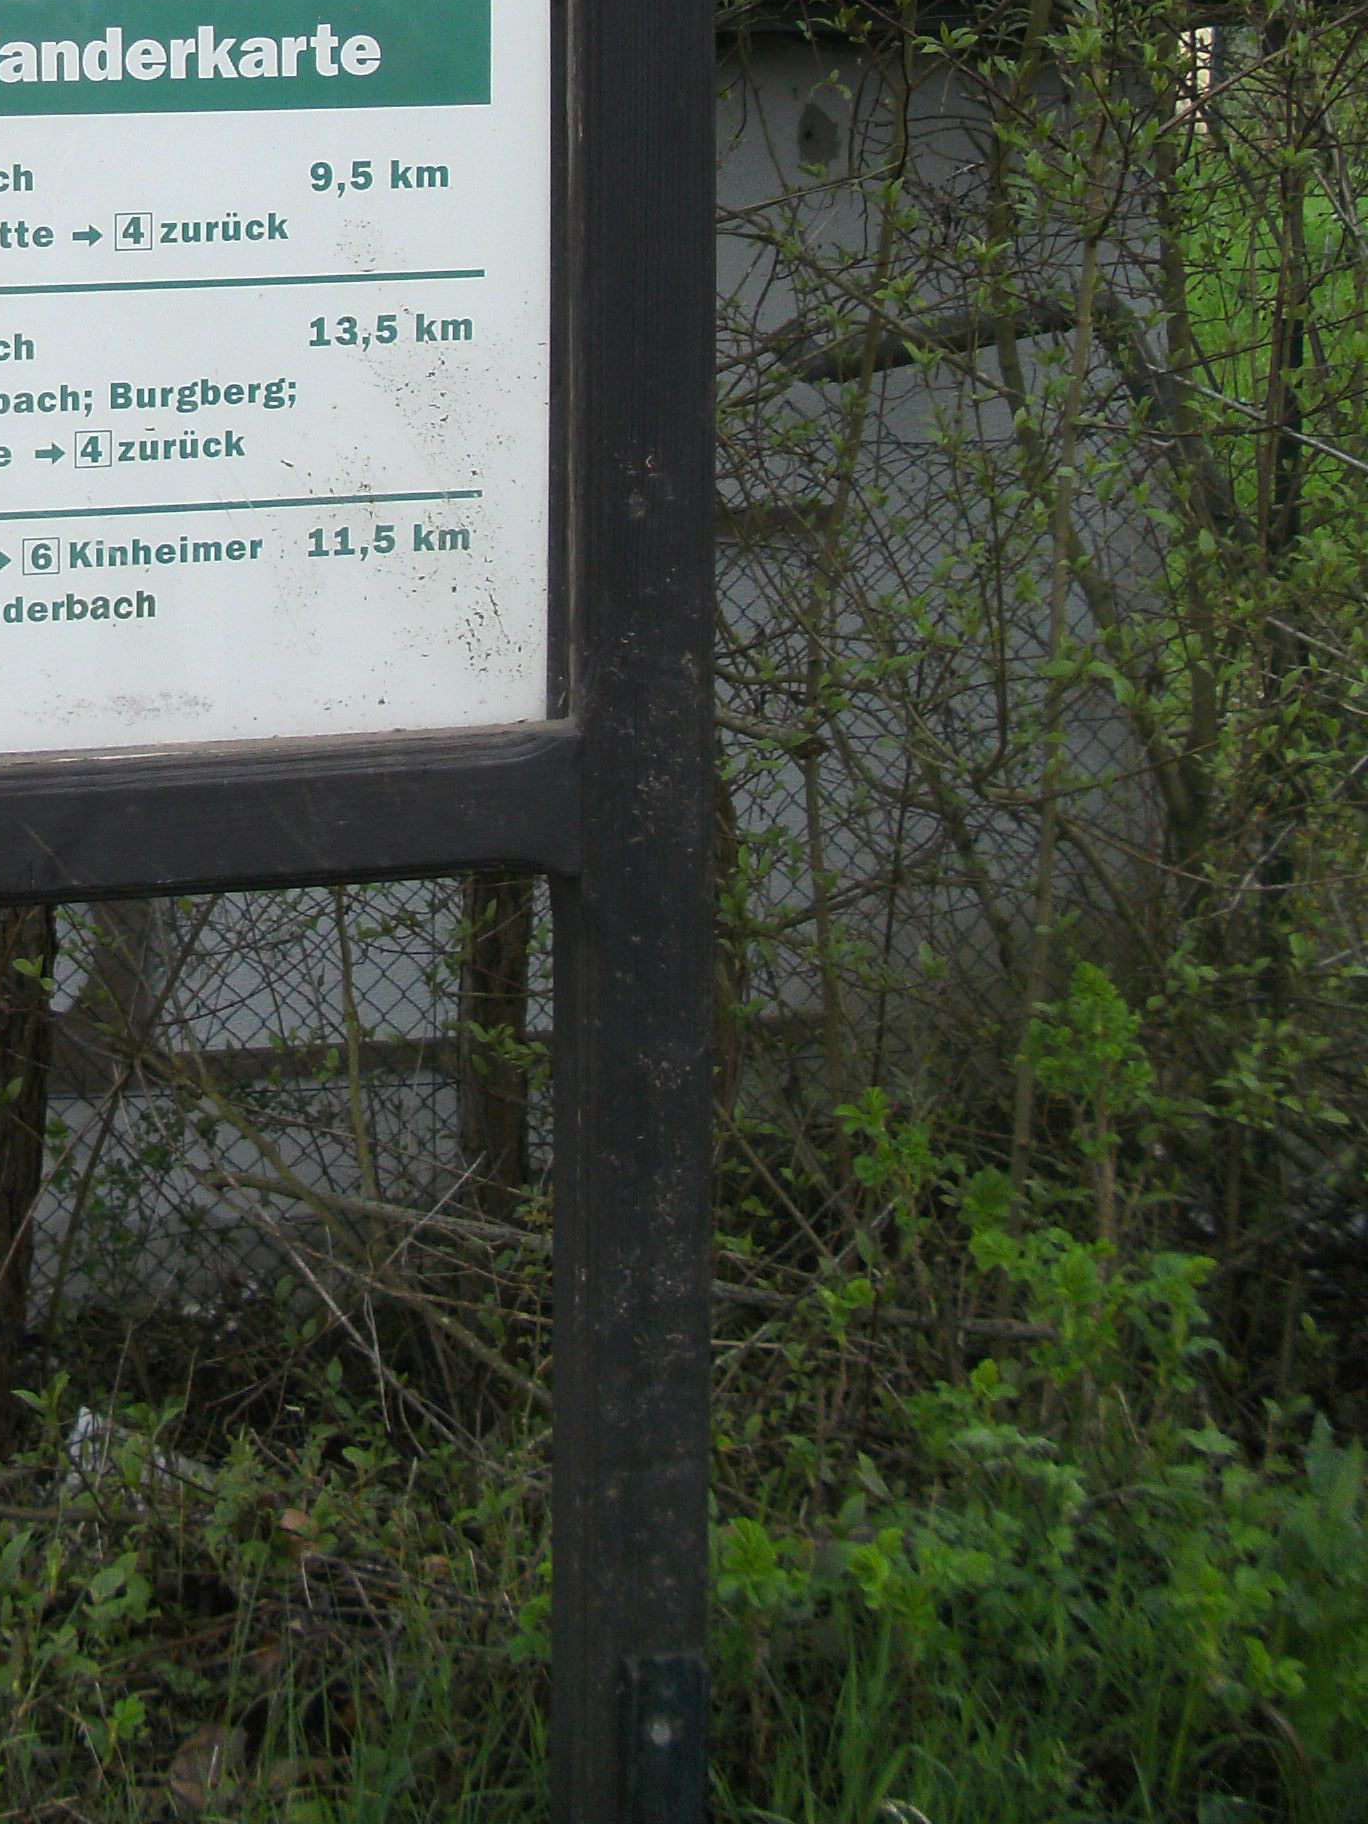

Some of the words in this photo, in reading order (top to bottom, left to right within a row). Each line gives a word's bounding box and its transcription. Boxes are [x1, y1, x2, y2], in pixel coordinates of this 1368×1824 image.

[310, 160, 374, 198] 9,5
[390, 159, 449, 190] km
[121, 216, 145, 245] 4
[159, 212, 289, 244] zurück
[309, 314, 399, 353] 13,5
[415, 313, 473, 343] km
[109, 377, 297, 414] Burgberg;
[80, 435, 103, 464] 4
[117, 429, 246, 463] zurück
[30, 542, 53, 571] 6
[69, 535, 263, 569] Kinheimer
[307, 524, 396, 562] 11,5
[413, 523, 471, 552] km
